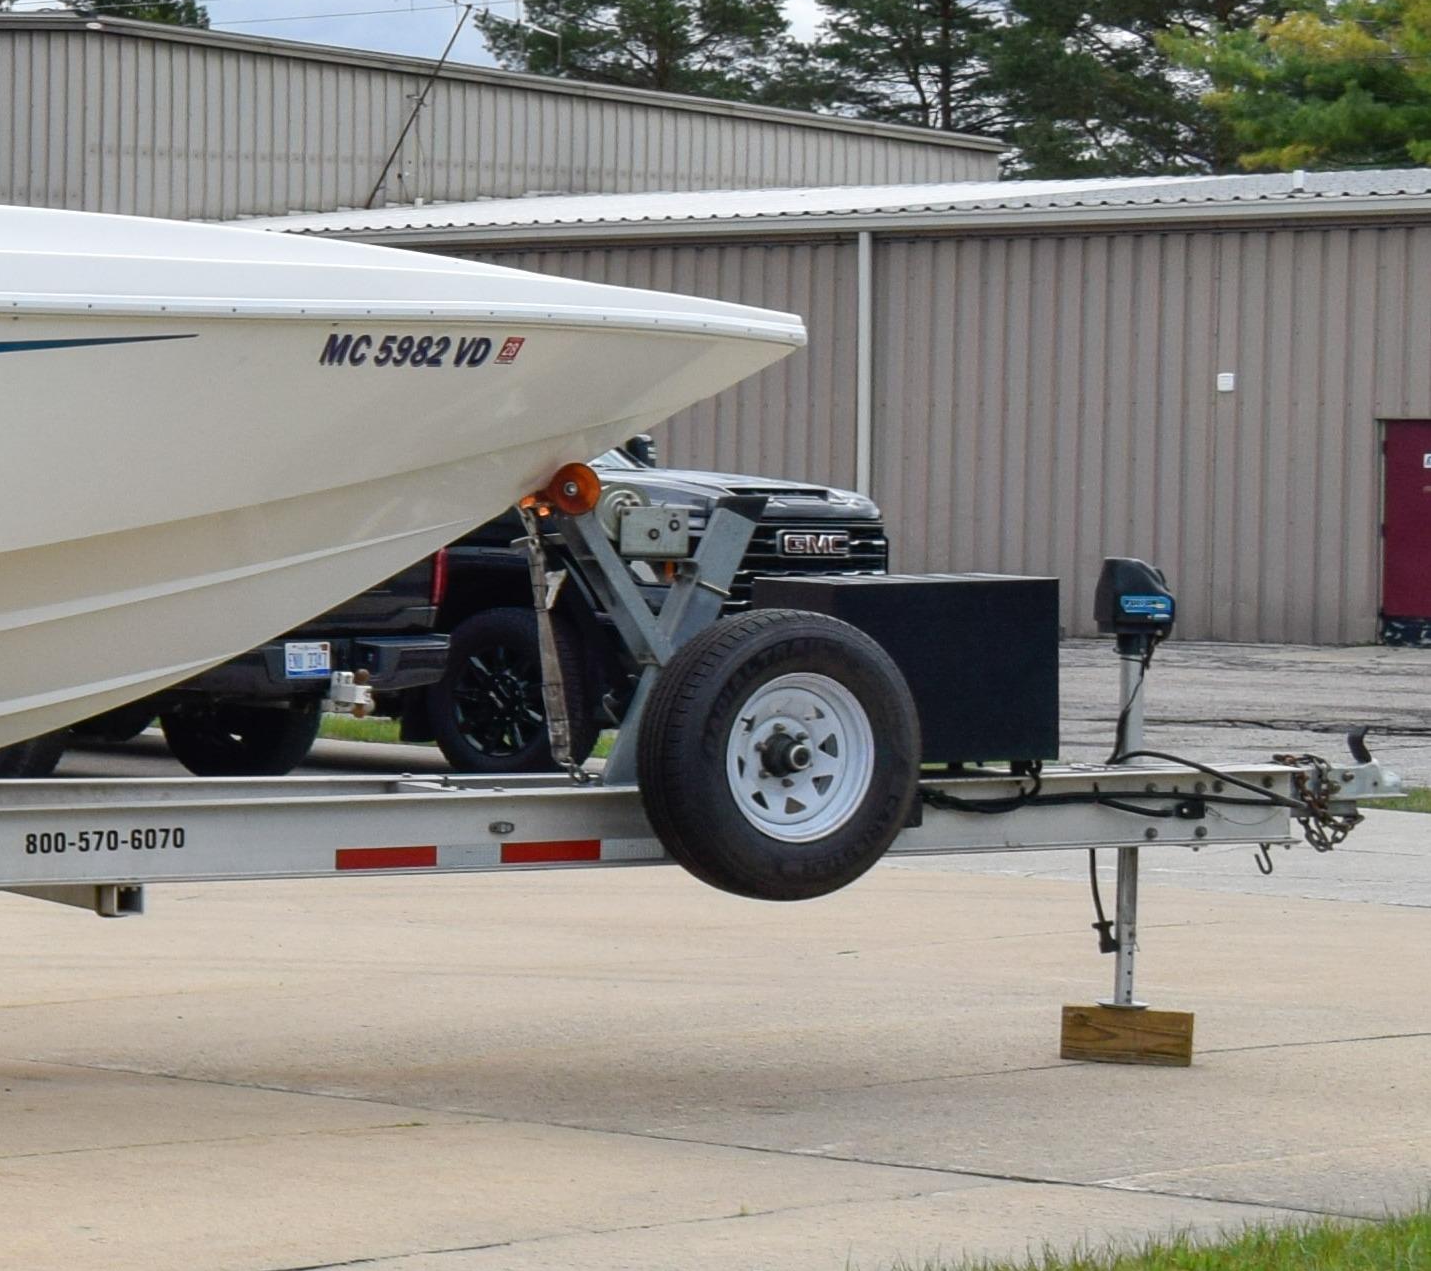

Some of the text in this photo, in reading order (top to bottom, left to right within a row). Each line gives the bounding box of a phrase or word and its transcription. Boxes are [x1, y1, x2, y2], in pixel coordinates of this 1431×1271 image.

[318, 333, 373, 367] MC
[373, 334, 452, 368] 5982
[453, 336, 493, 368] VD
[783, 534, 849, 554] GMC
[24, 827, 186, 855] 800-570-6070
